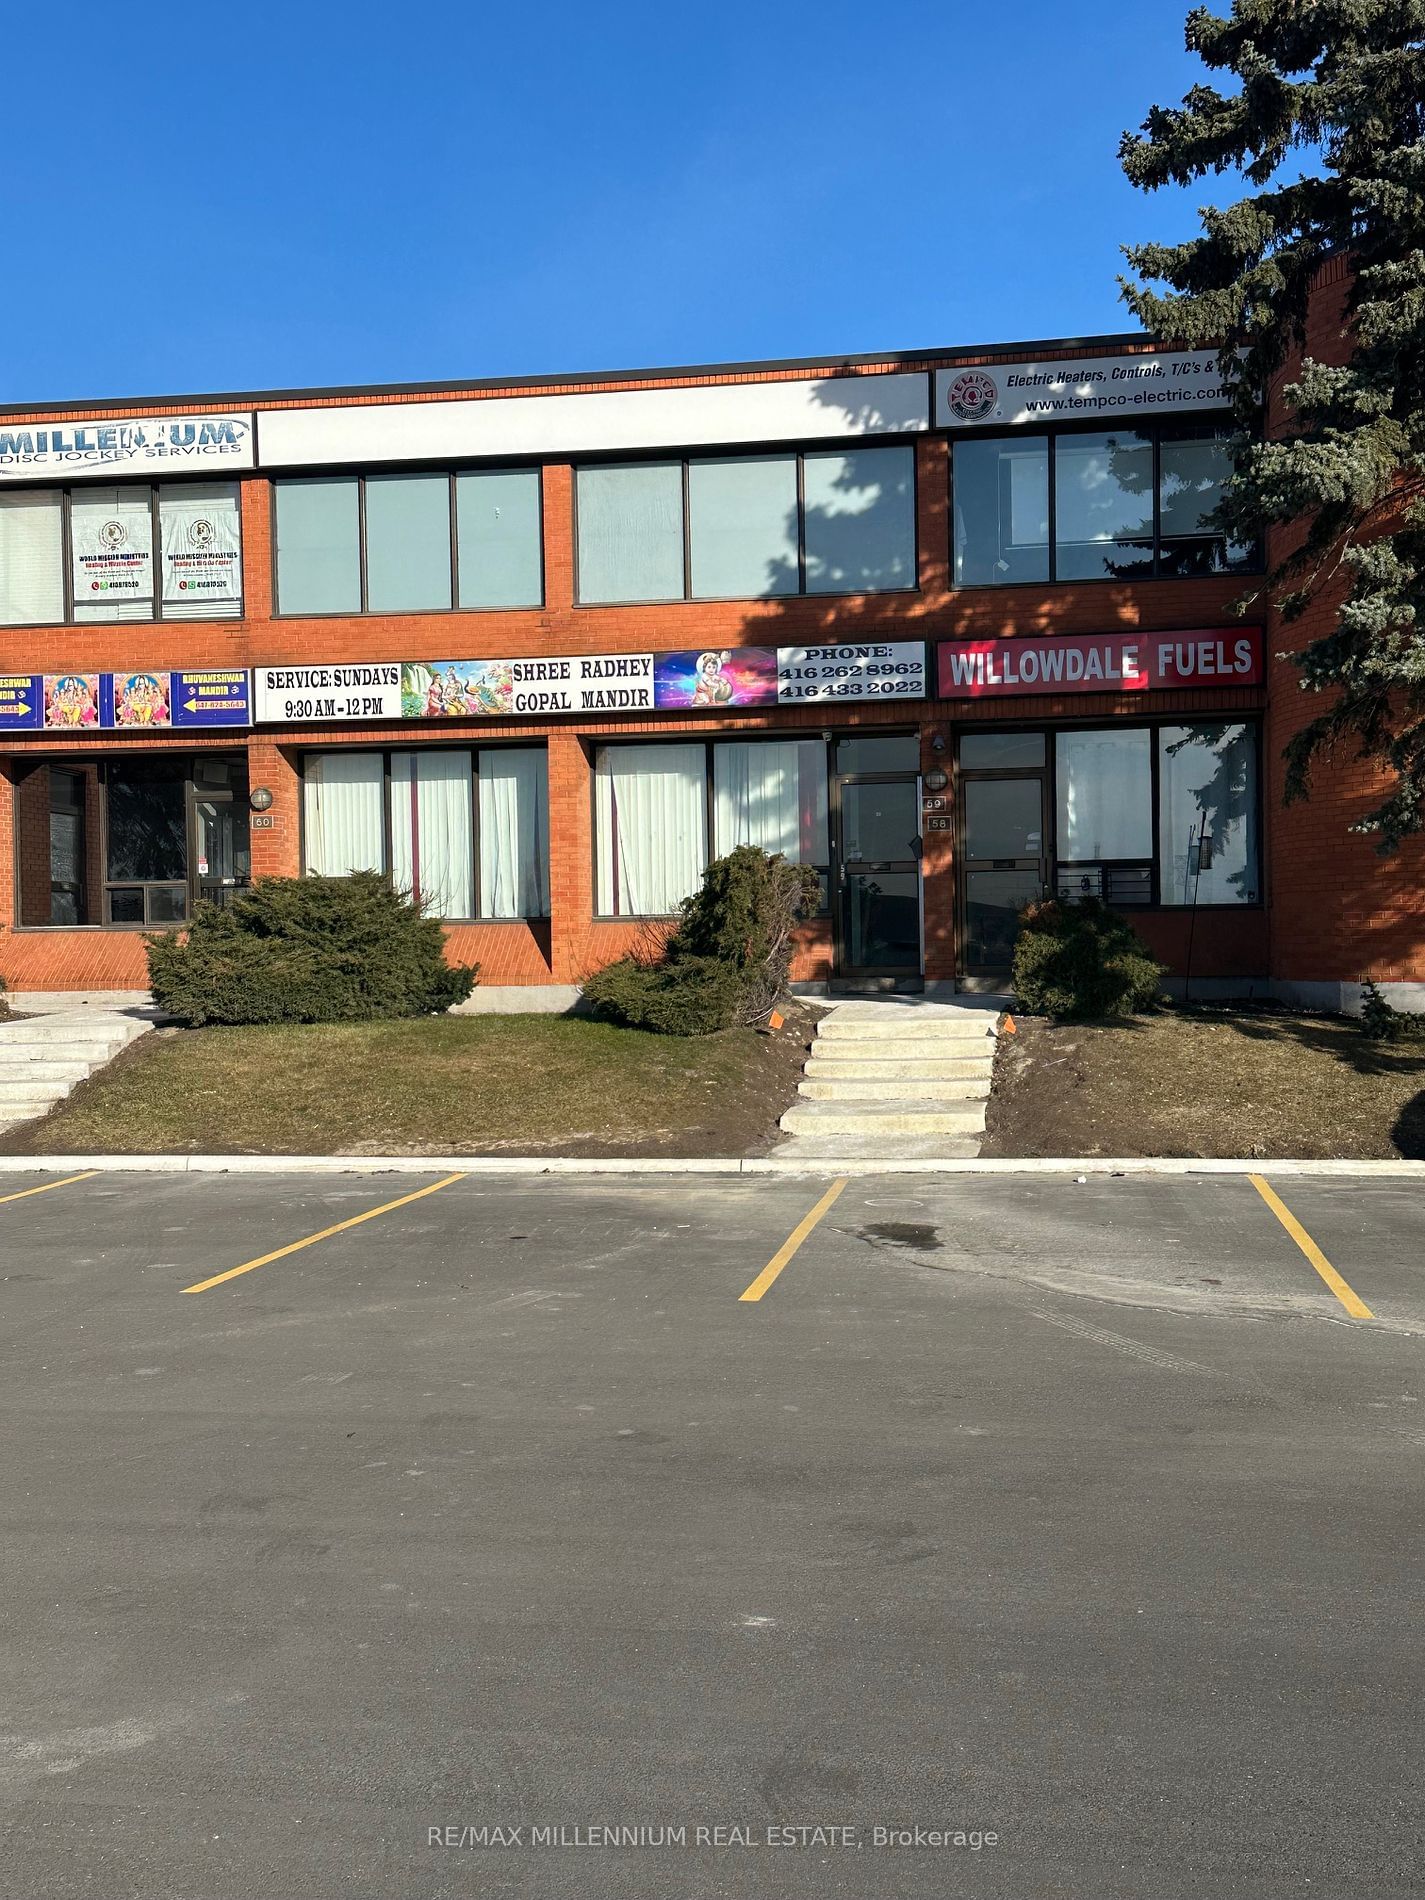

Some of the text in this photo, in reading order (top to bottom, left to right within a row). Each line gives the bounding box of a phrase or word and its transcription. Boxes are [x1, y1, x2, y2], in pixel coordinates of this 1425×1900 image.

[1007, 373, 1054, 388] Electric
[1056, 369, 1107, 385] Heaters,
[1111, 365, 1166, 381] Controls,
[1171, 361, 1202, 376] T/C's
[1204, 361, 1214, 372] &
[0, 444, 241, 464] DISC JOCKEY SERVICES
[805, 646, 894, 661] PHONE:
[950, 639, 1252, 686] WILLOWDALE FUELS
[267, 667, 399, 690] SERVICE: SUNDAYS
[513, 658, 651, 682] SHREE RADHEY
[778, 663, 923, 681] 416 262 8962
[778, 680, 923, 698] 416 433 2022
[284, 700, 313, 719] 9:30
[515, 689, 650, 713] GOPAL MANDIR
[927, 800, 941, 808] 59
[932, 820, 946, 828] 58
